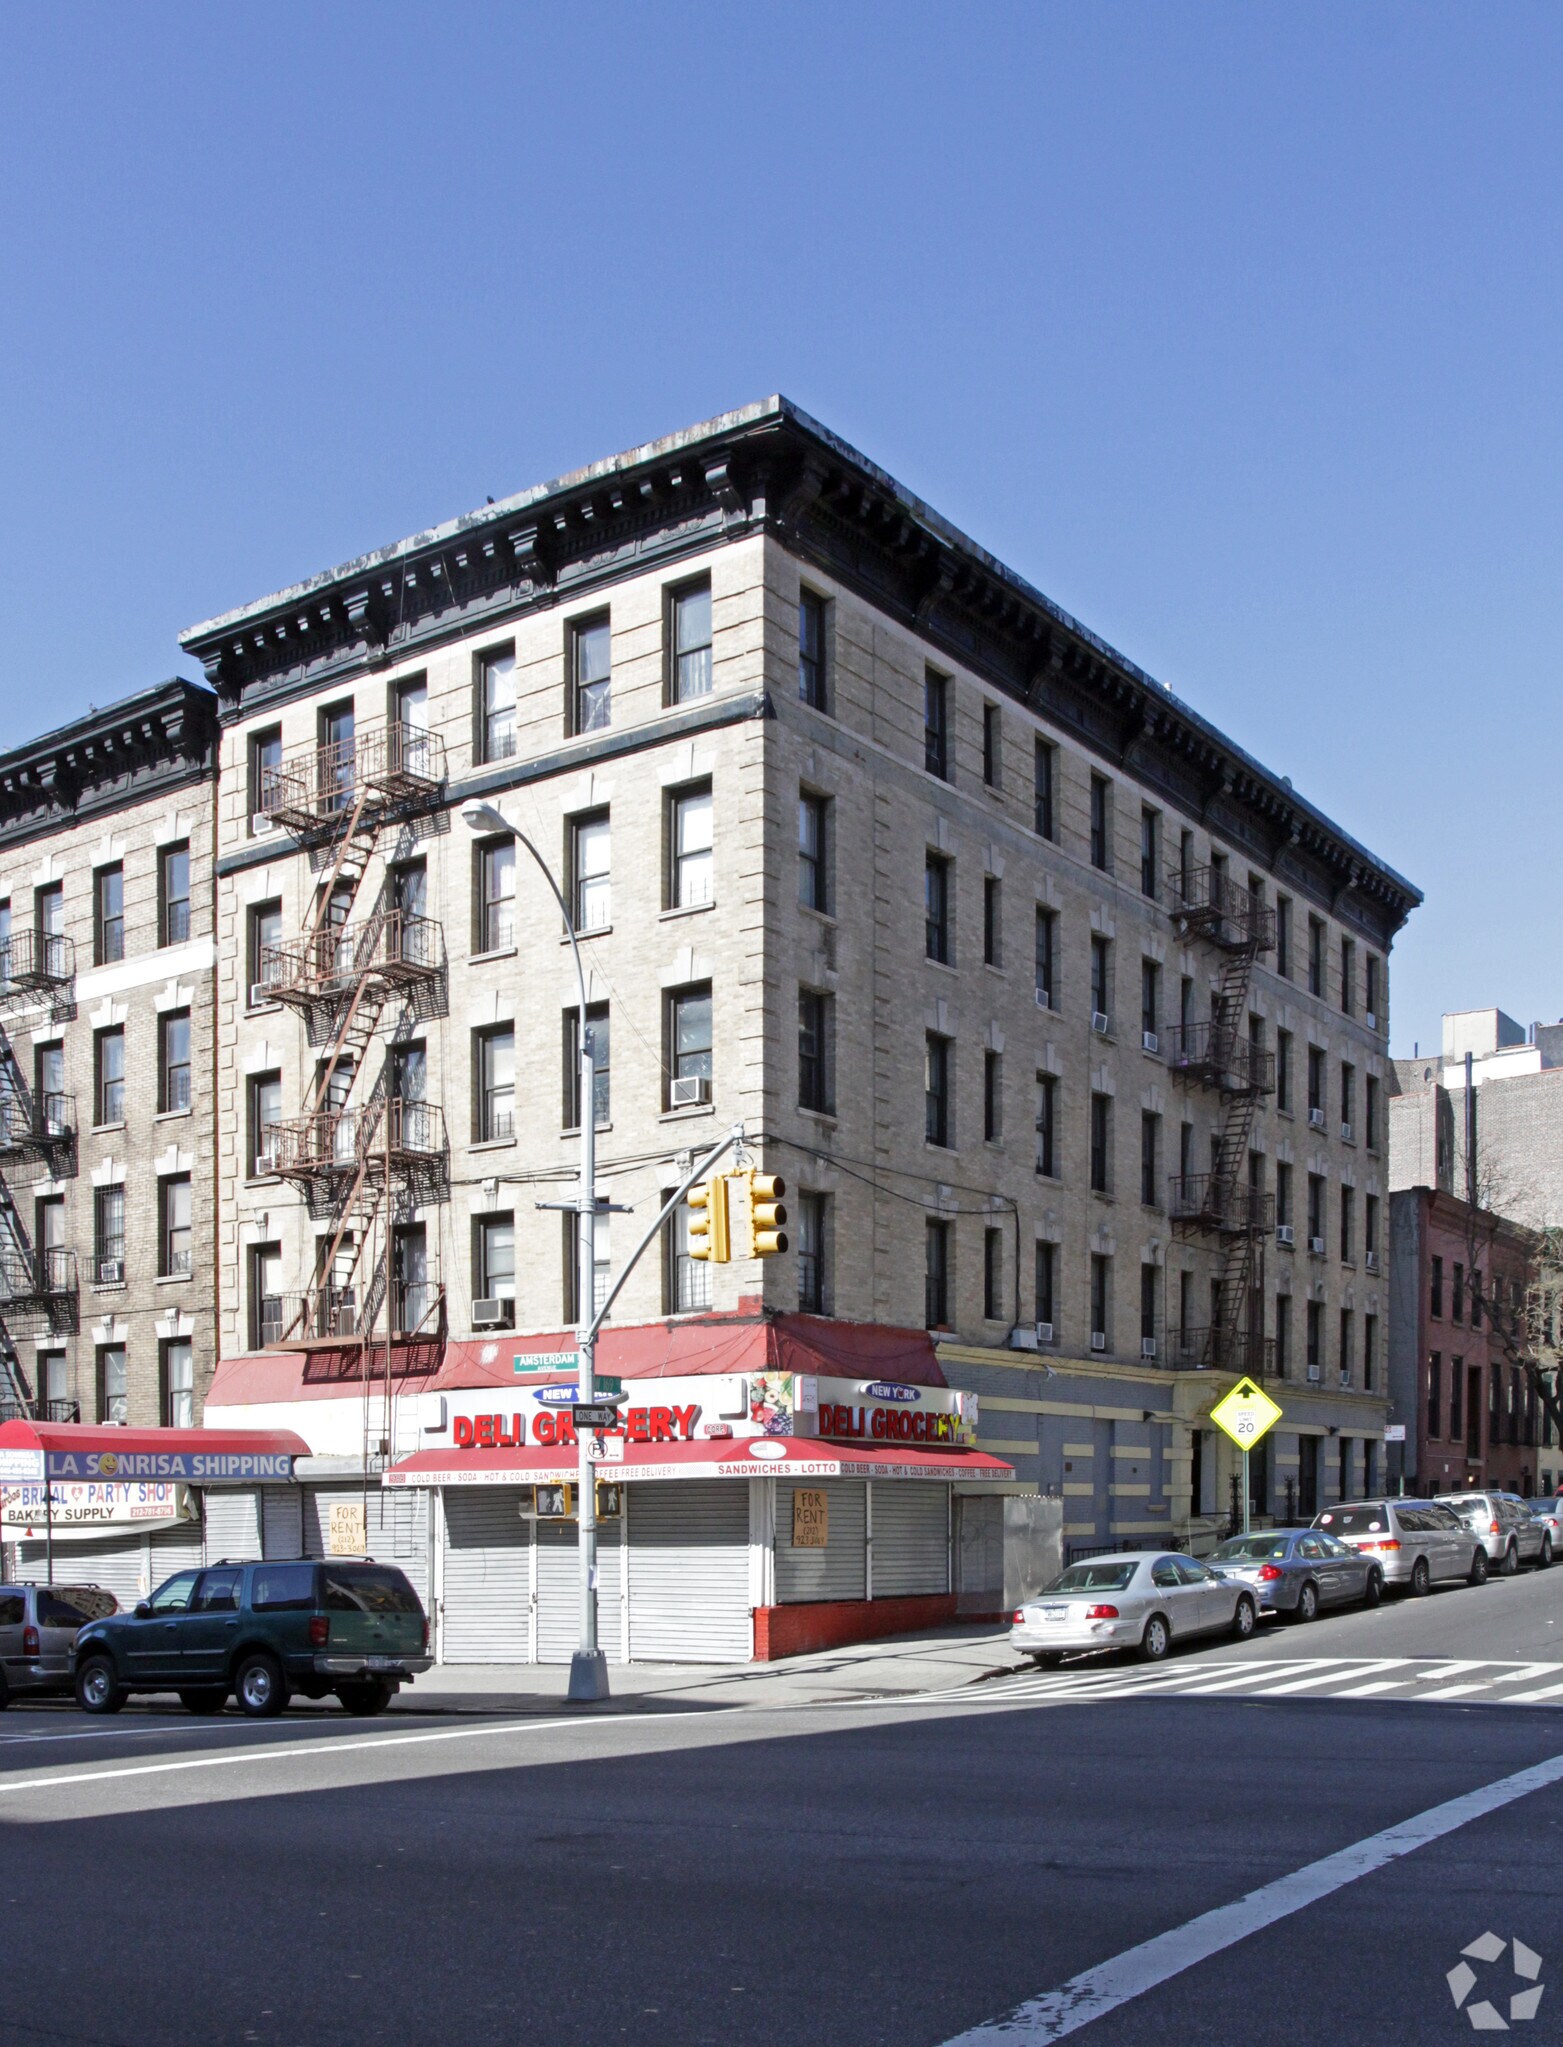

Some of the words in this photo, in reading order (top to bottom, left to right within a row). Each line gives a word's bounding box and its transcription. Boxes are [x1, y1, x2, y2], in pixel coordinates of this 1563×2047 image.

[520, 1354, 575, 1366] AMSTERDAM
[543, 1388, 573, 1400] NEW
[871, 1384, 891, 1397] NEW
[578, 1411, 592, 1420] ONE
[597, 1411, 611, 1421] WAY
[819, 1404, 865, 1438] DELI
[453, 1413, 521, 1445] DELI
[532, 1404, 698, 1444] GRERY
[1238, 1422, 1254, 1433] 20
[48, 1454, 80, 1475] LA
[192, 1455, 290, 1475] SHIPPING
[718, 1463, 791, 1474] SANDWICHES
[801, 1463, 836, 1473] LOTTO
[841, 1463, 856, 1473] COLD
[856, 1463, 870, 1473] BEER
[875, 1464, 889, 1474] SODA
[892, 1465, 902, 1475] HOT
[910, 1466, 923, 1476] COLD
[412, 1474, 430, 1483] COLD
[433, 1473, 451, 1482] BEER
[458, 1473, 477, 1481] SODA
[485, 1472, 499, 1481] HOT
[510, 1472, 529, 1480] COLD
[534, 1470, 579, 1480] SANDWICHE
[595, 1469, 619, 1478] OFFEE
[621, 1468, 639, 1477] FREE
[641, 1466, 676, 1476] DELIVERY
[22, 1486, 68, 1506] BRIAL
[88, 1483, 131, 1503] PARTY
[138, 1482, 173, 1502] SHOP
[801, 1492, 822, 1507] FOR
[65, 1507, 114, 1520] SUPPLY
[336, 1506, 357, 1519] FOR
[796, 1508, 825, 1524] RENT
[331, 1522, 362, 1534] RENT
[338, 1534, 355, 1545] (212)
